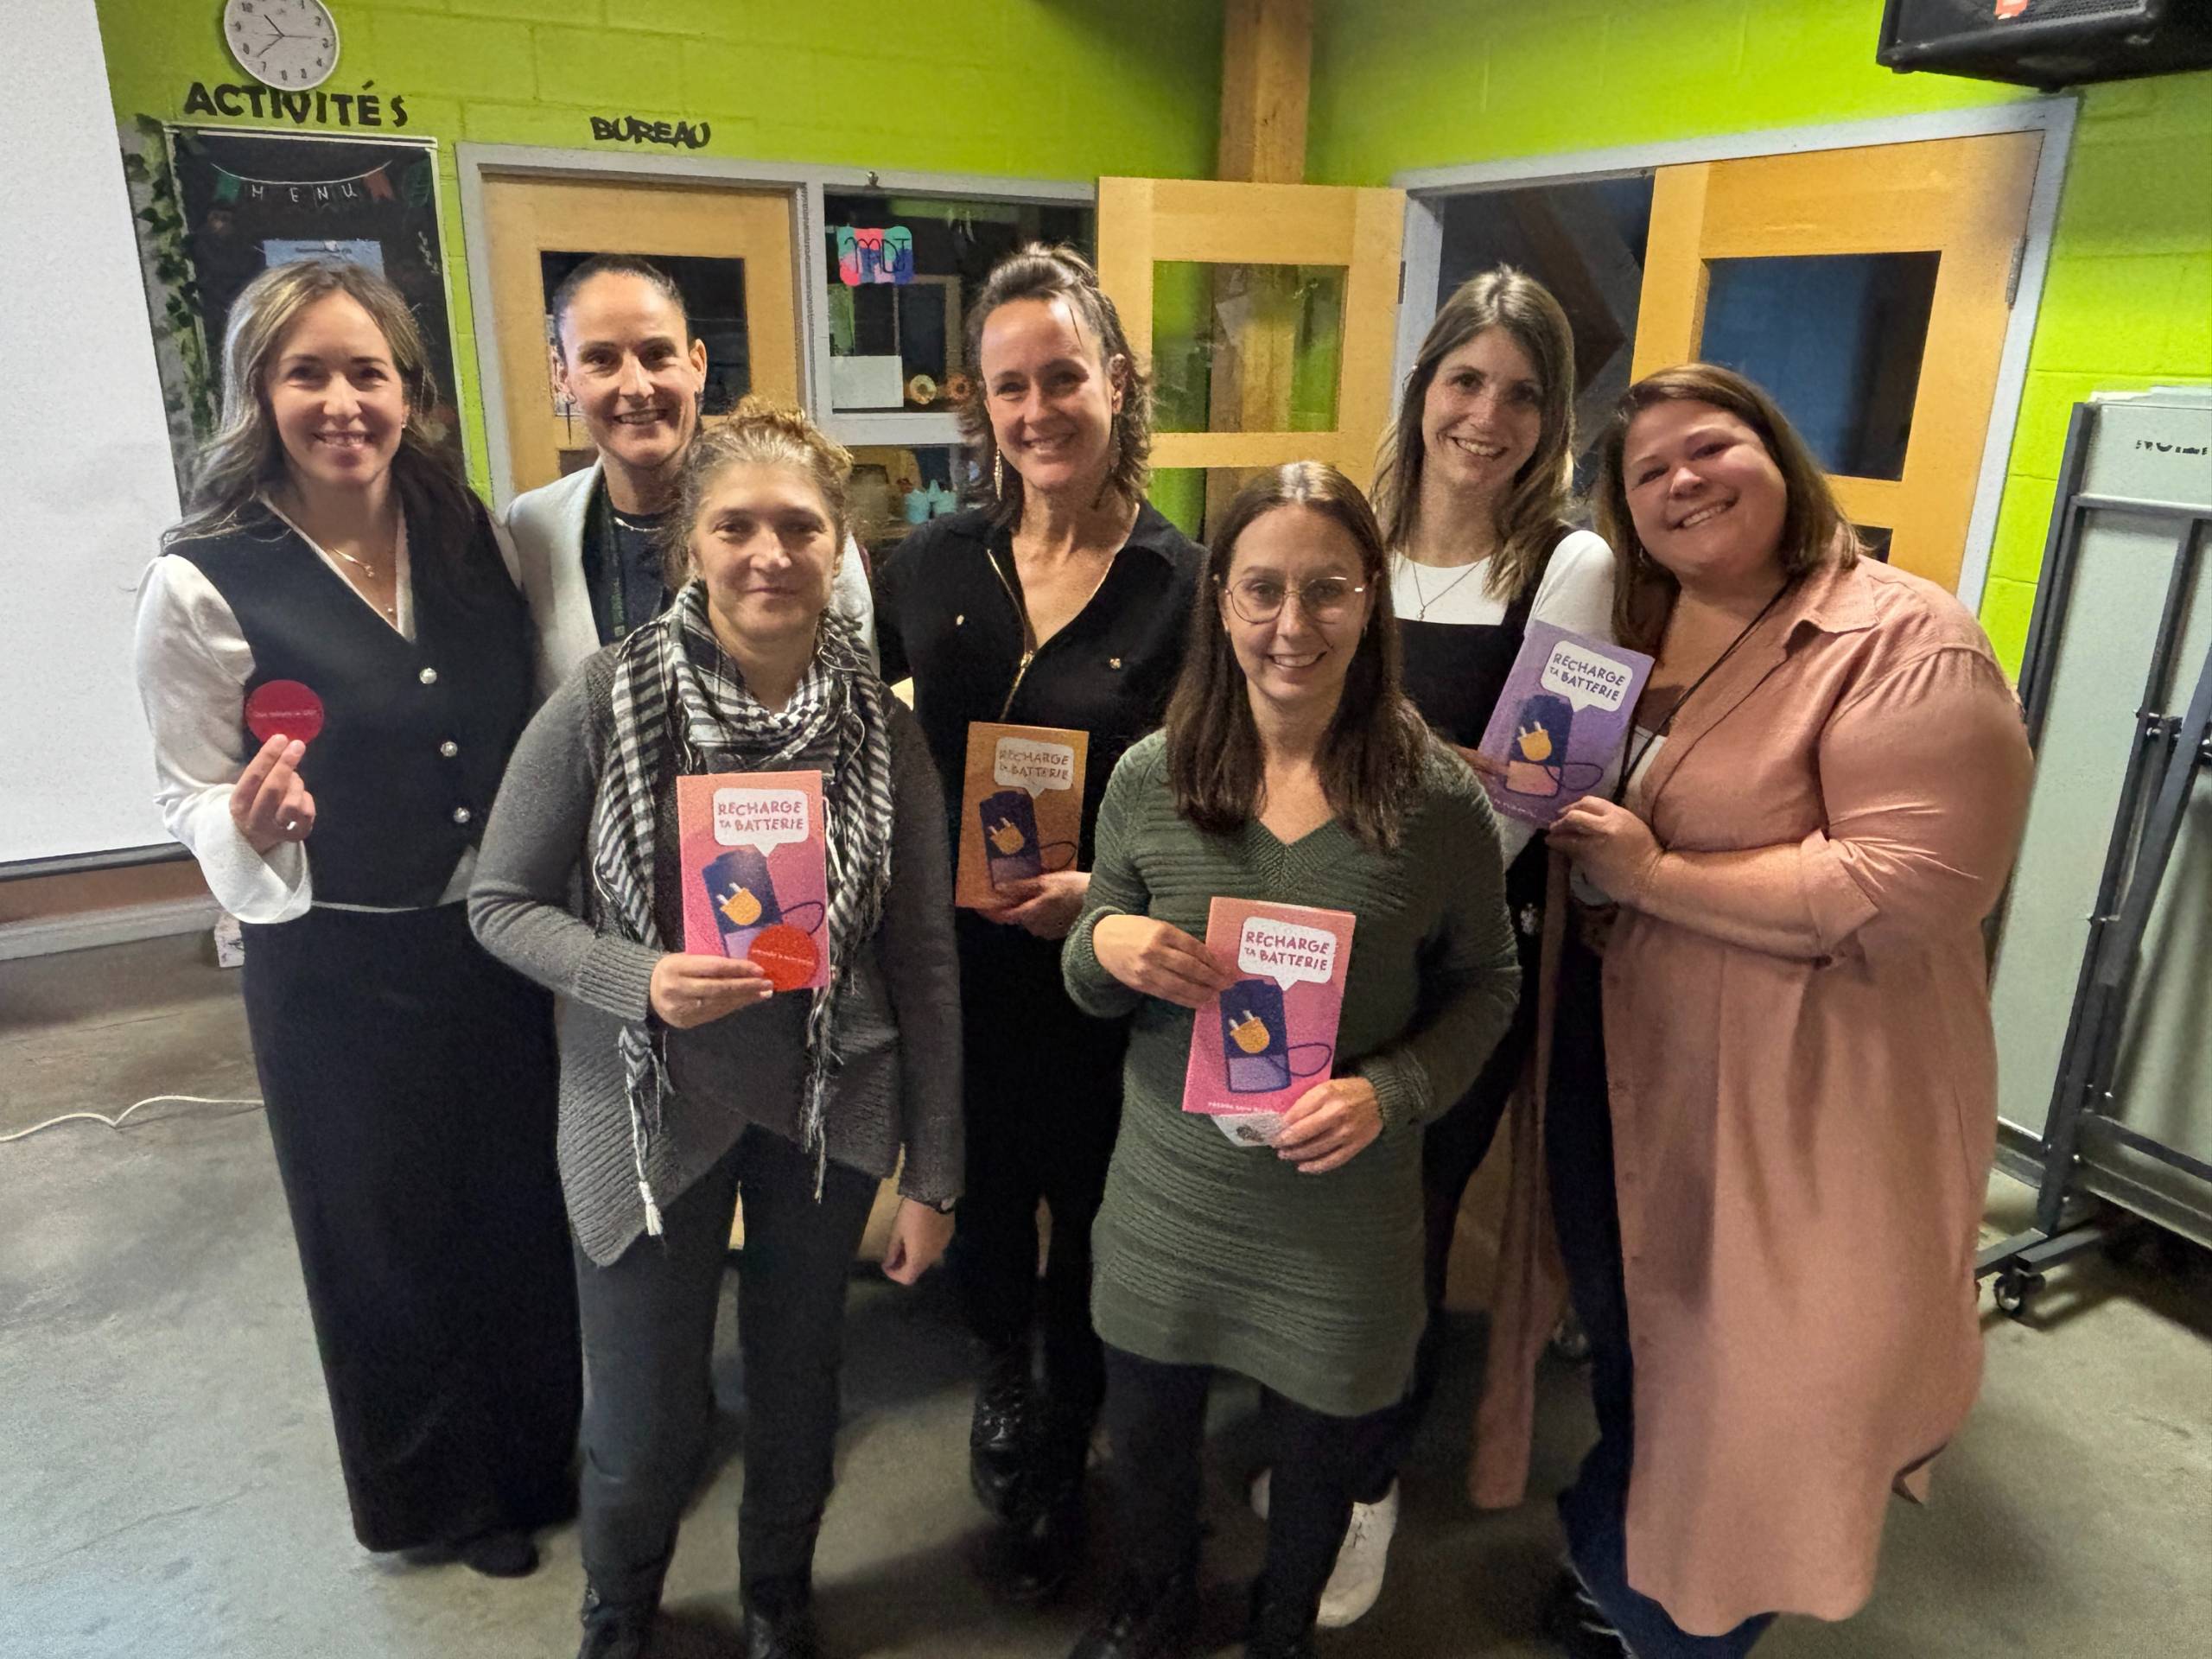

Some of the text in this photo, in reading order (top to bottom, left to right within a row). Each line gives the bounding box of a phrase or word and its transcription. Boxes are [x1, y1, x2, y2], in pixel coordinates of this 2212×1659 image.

[184, 80, 408, 127] ACTIVITÉS
[589, 115, 711, 149] BUREAU
[1553, 652, 1626, 686] RECHARGE
[1560, 671, 1620, 702] BATTERIE
[718, 801, 802, 816] RECHARGE
[719, 817, 804, 831] TA BATTERIE
[1245, 931, 1330, 955] RECHARGE
[1259, 950, 1328, 971] BATTERIE
